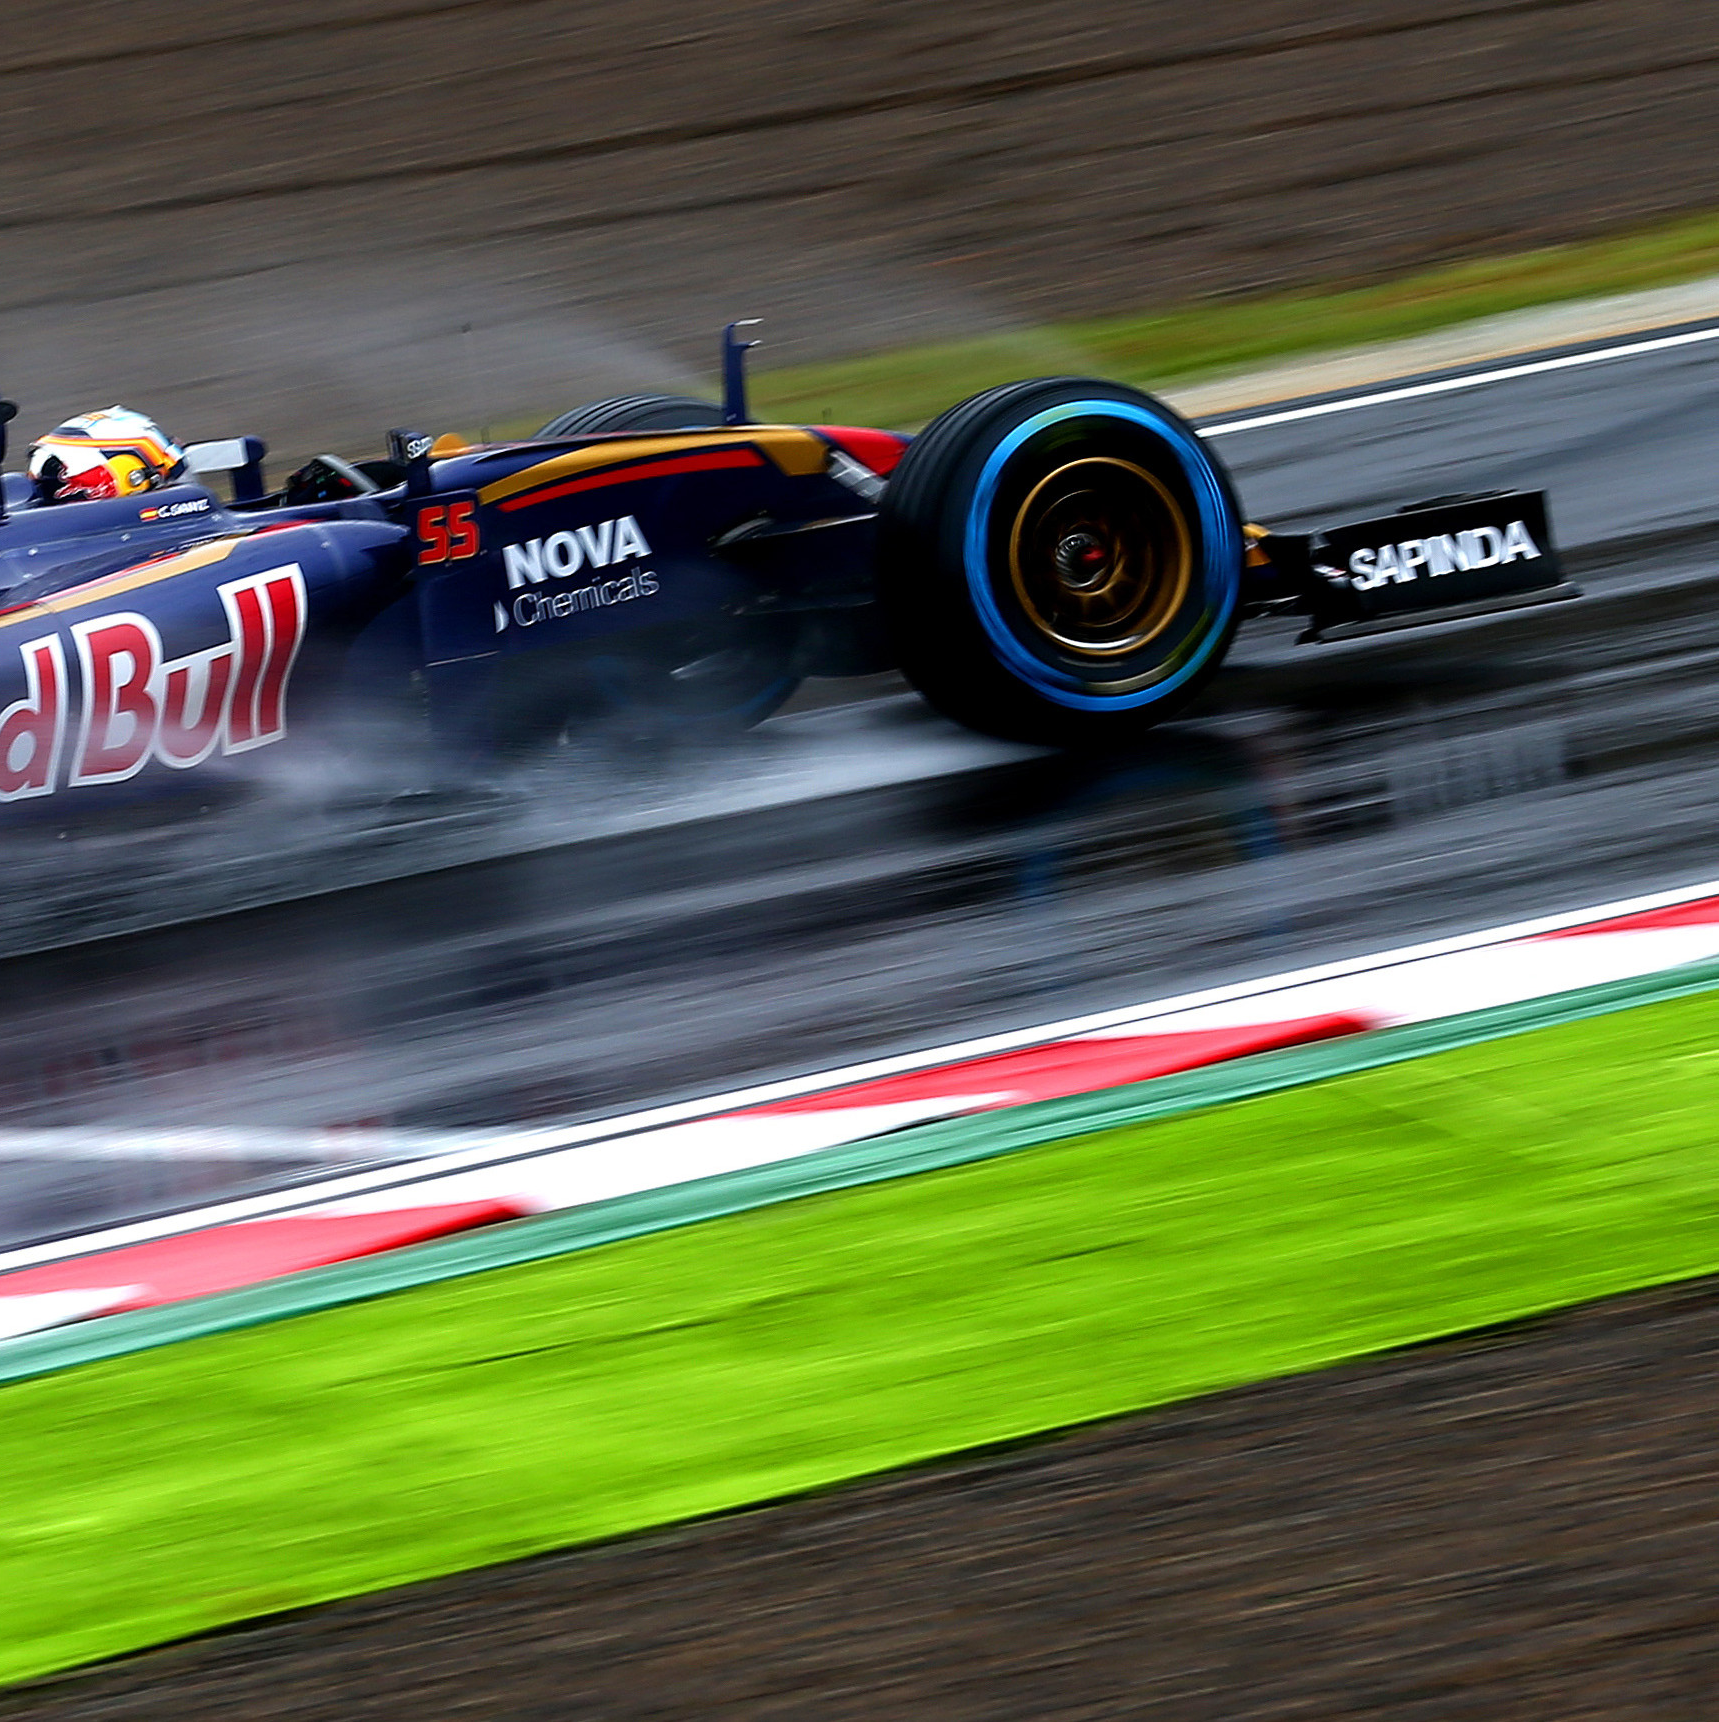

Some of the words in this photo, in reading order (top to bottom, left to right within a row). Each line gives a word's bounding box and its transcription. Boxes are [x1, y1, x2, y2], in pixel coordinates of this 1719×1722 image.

[418, 500, 480, 567] 55
[502, 515, 652, 590] NOVA
[1349, 520, 1543, 592] SAPINDA
[513, 566, 660, 627] Chemicals
[69, 562, 307, 788] Bull
